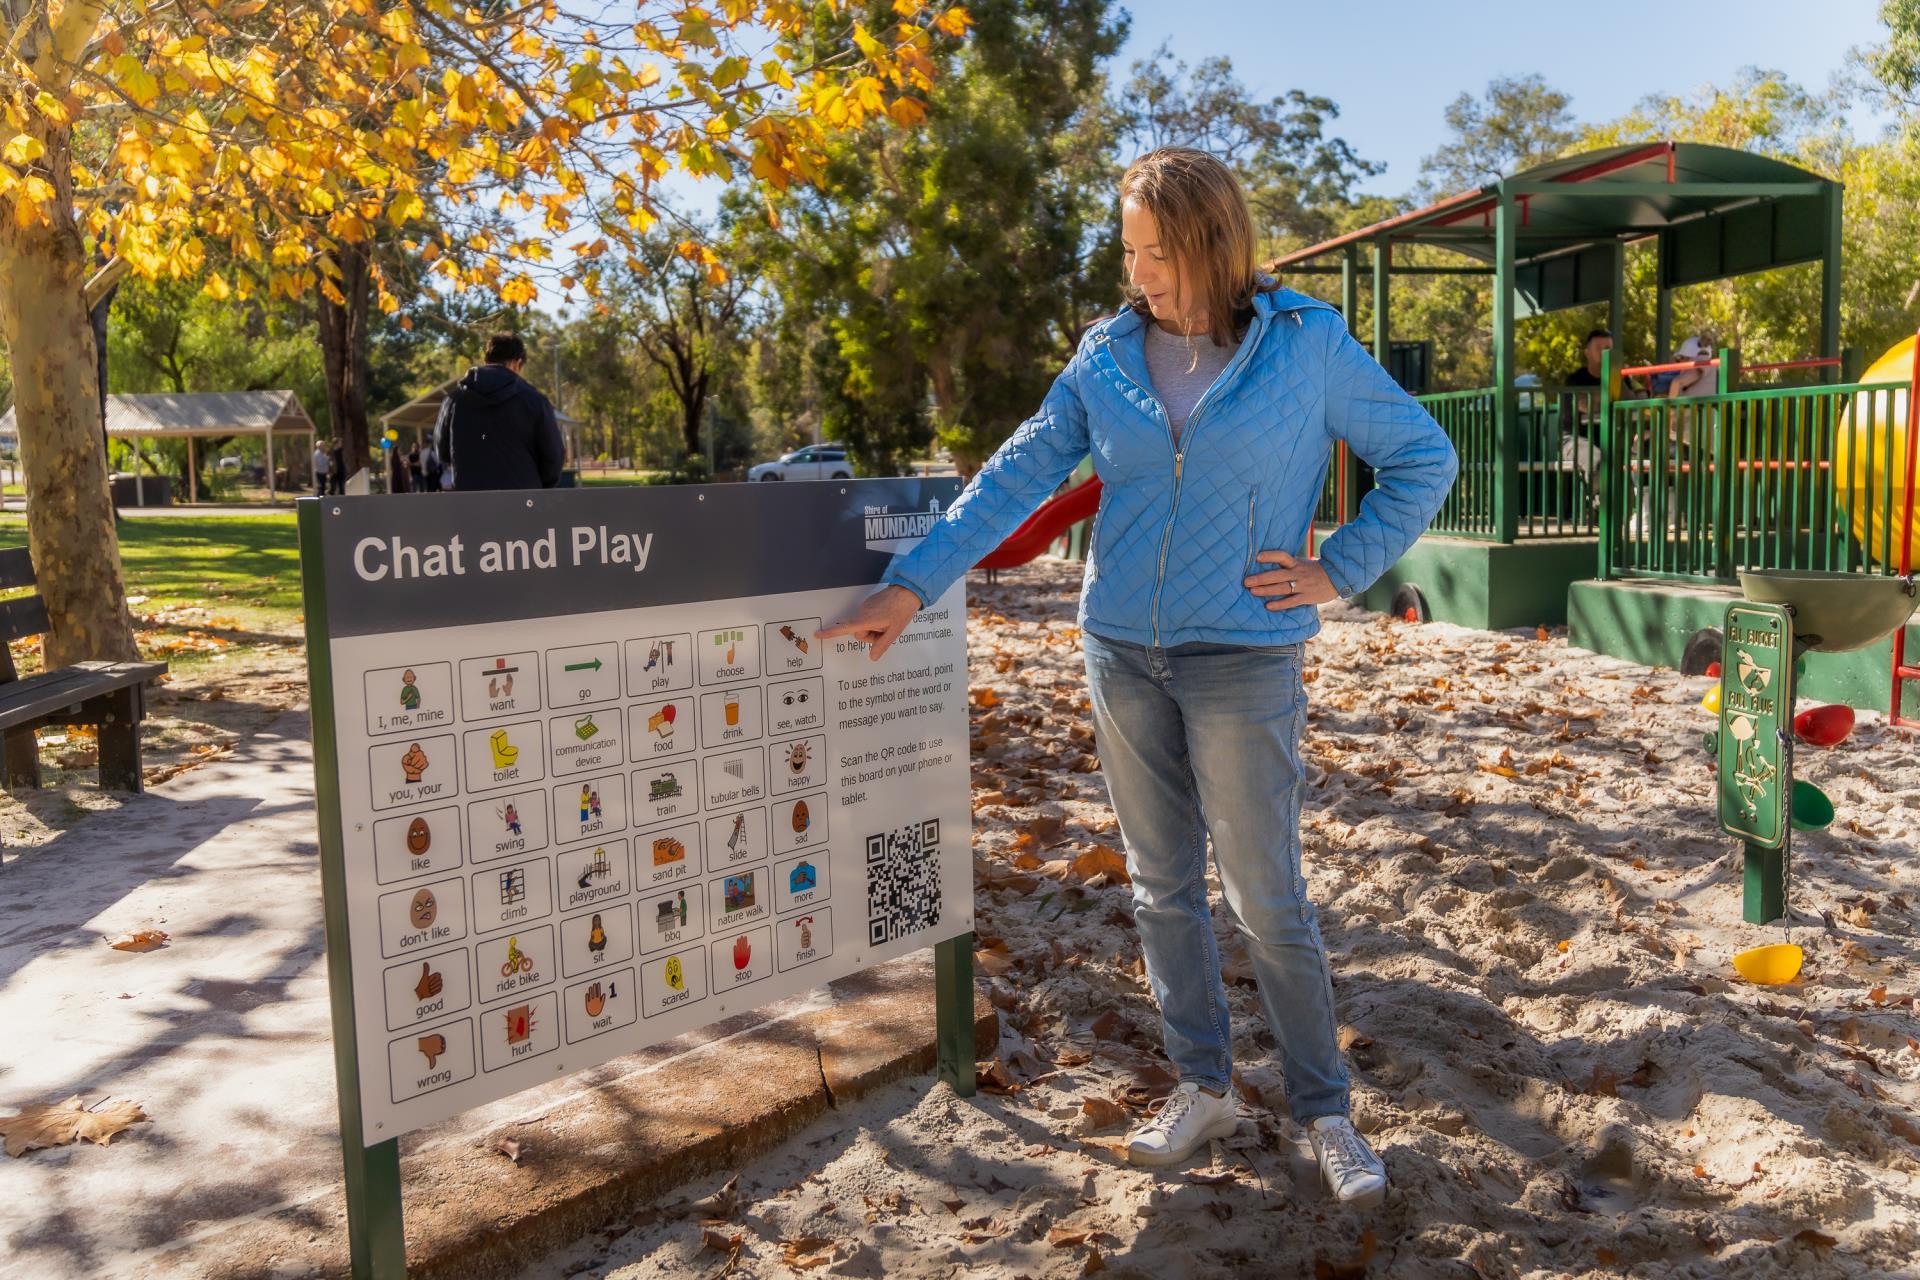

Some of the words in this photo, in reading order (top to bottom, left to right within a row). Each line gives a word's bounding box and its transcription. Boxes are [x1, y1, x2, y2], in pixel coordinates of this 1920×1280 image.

[865, 505, 880, 514] Shire
[882, 505, 888, 514] of
[864, 514, 945, 540] MUNDARIN
[354, 534, 466, 582] Chat
[480, 528, 556, 572] and
[572, 526, 654, 572] Play
[912, 609, 948, 624] designed
[836, 642, 845, 653] to
[848, 640, 866, 652] help
[898, 628, 954, 644] communicate.
[787, 657, 803, 668] help
[716, 666, 744, 678] choose
[838, 680, 849, 691] To
[852, 678, 868, 690] use
[870, 674, 885, 686] this
[888, 671, 904, 684] chat
[907, 667, 932, 680] board,
[934, 663, 954, 677] point
[652, 676, 670, 690] play
[579, 689, 591, 700] go
[838, 701, 846, 710] to
[849, 695, 862, 708] the
[866, 690, 896, 706] symbol
[898, 688, 905, 700] of
[908, 687, 920, 698] the
[922, 683, 942, 695] word
[944, 682, 951, 691] or
[490, 699, 514, 711] want
[378, 716, 387, 729] I,
[391, 715, 412, 728] me,
[416, 710, 444, 723] mine
[777, 719, 792, 729] see,
[795, 714, 816, 726] watch
[840, 715, 878, 731] message
[881, 711, 896, 722] you
[898, 707, 918, 719] want
[920, 705, 927, 714] to
[929, 702, 944, 713] say.
[723, 727, 743, 740] drink
[556, 738, 616, 756] communication
[654, 740, 672, 752] food
[840, 754, 862, 768] Scan
[865, 750, 878, 762] the
[881, 747, 895, 760] QR
[897, 743, 916, 756] code
[919, 741, 926, 751] to
[929, 738, 943, 748] use
[576, 754, 602, 767] device
[493, 768, 519, 782] toilet
[841, 774, 856, 788] this
[859, 768, 883, 782] board
[886, 768, 896, 776] on
[898, 762, 916, 776] your
[918, 755, 942, 770] phone
[944, 754, 952, 763] or
[788, 774, 810, 788] happy
[388, 788, 414, 803] you,
[418, 784, 442, 800] your
[711, 789, 738, 804] tubular
[742, 785, 759, 798] bells
[841, 792, 868, 806] tablet.
[657, 803, 676, 816] train
[580, 820, 602, 836] push
[496, 836, 524, 852] swing
[795, 833, 808, 844] sad
[729, 850, 747, 861] slide
[411, 857, 430, 871] like
[653, 867, 672, 882] sand
[676, 864, 687, 877] pit
[569, 880, 620, 904] playground
[794, 890, 814, 903] more
[501, 906, 527, 920] climb
[718, 911, 744, 926] nature
[746, 904, 764, 918] walk
[400, 930, 428, 948] don't
[432, 926, 450, 941] like
[664, 929, 680, 942] bbq
[594, 952, 605, 964] sit
[796, 948, 816, 962] finish
[496, 978, 516, 992] ride
[519, 972, 540, 986] bike
[735, 969, 752, 982] stop
[608, 982, 617, 998] 1
[662, 990, 690, 1006] scared
[416, 1000, 444, 1018] good
[592, 1016, 612, 1030] wait
[512, 1042, 532, 1057] hurt
[417, 1069, 450, 1089] wrong
